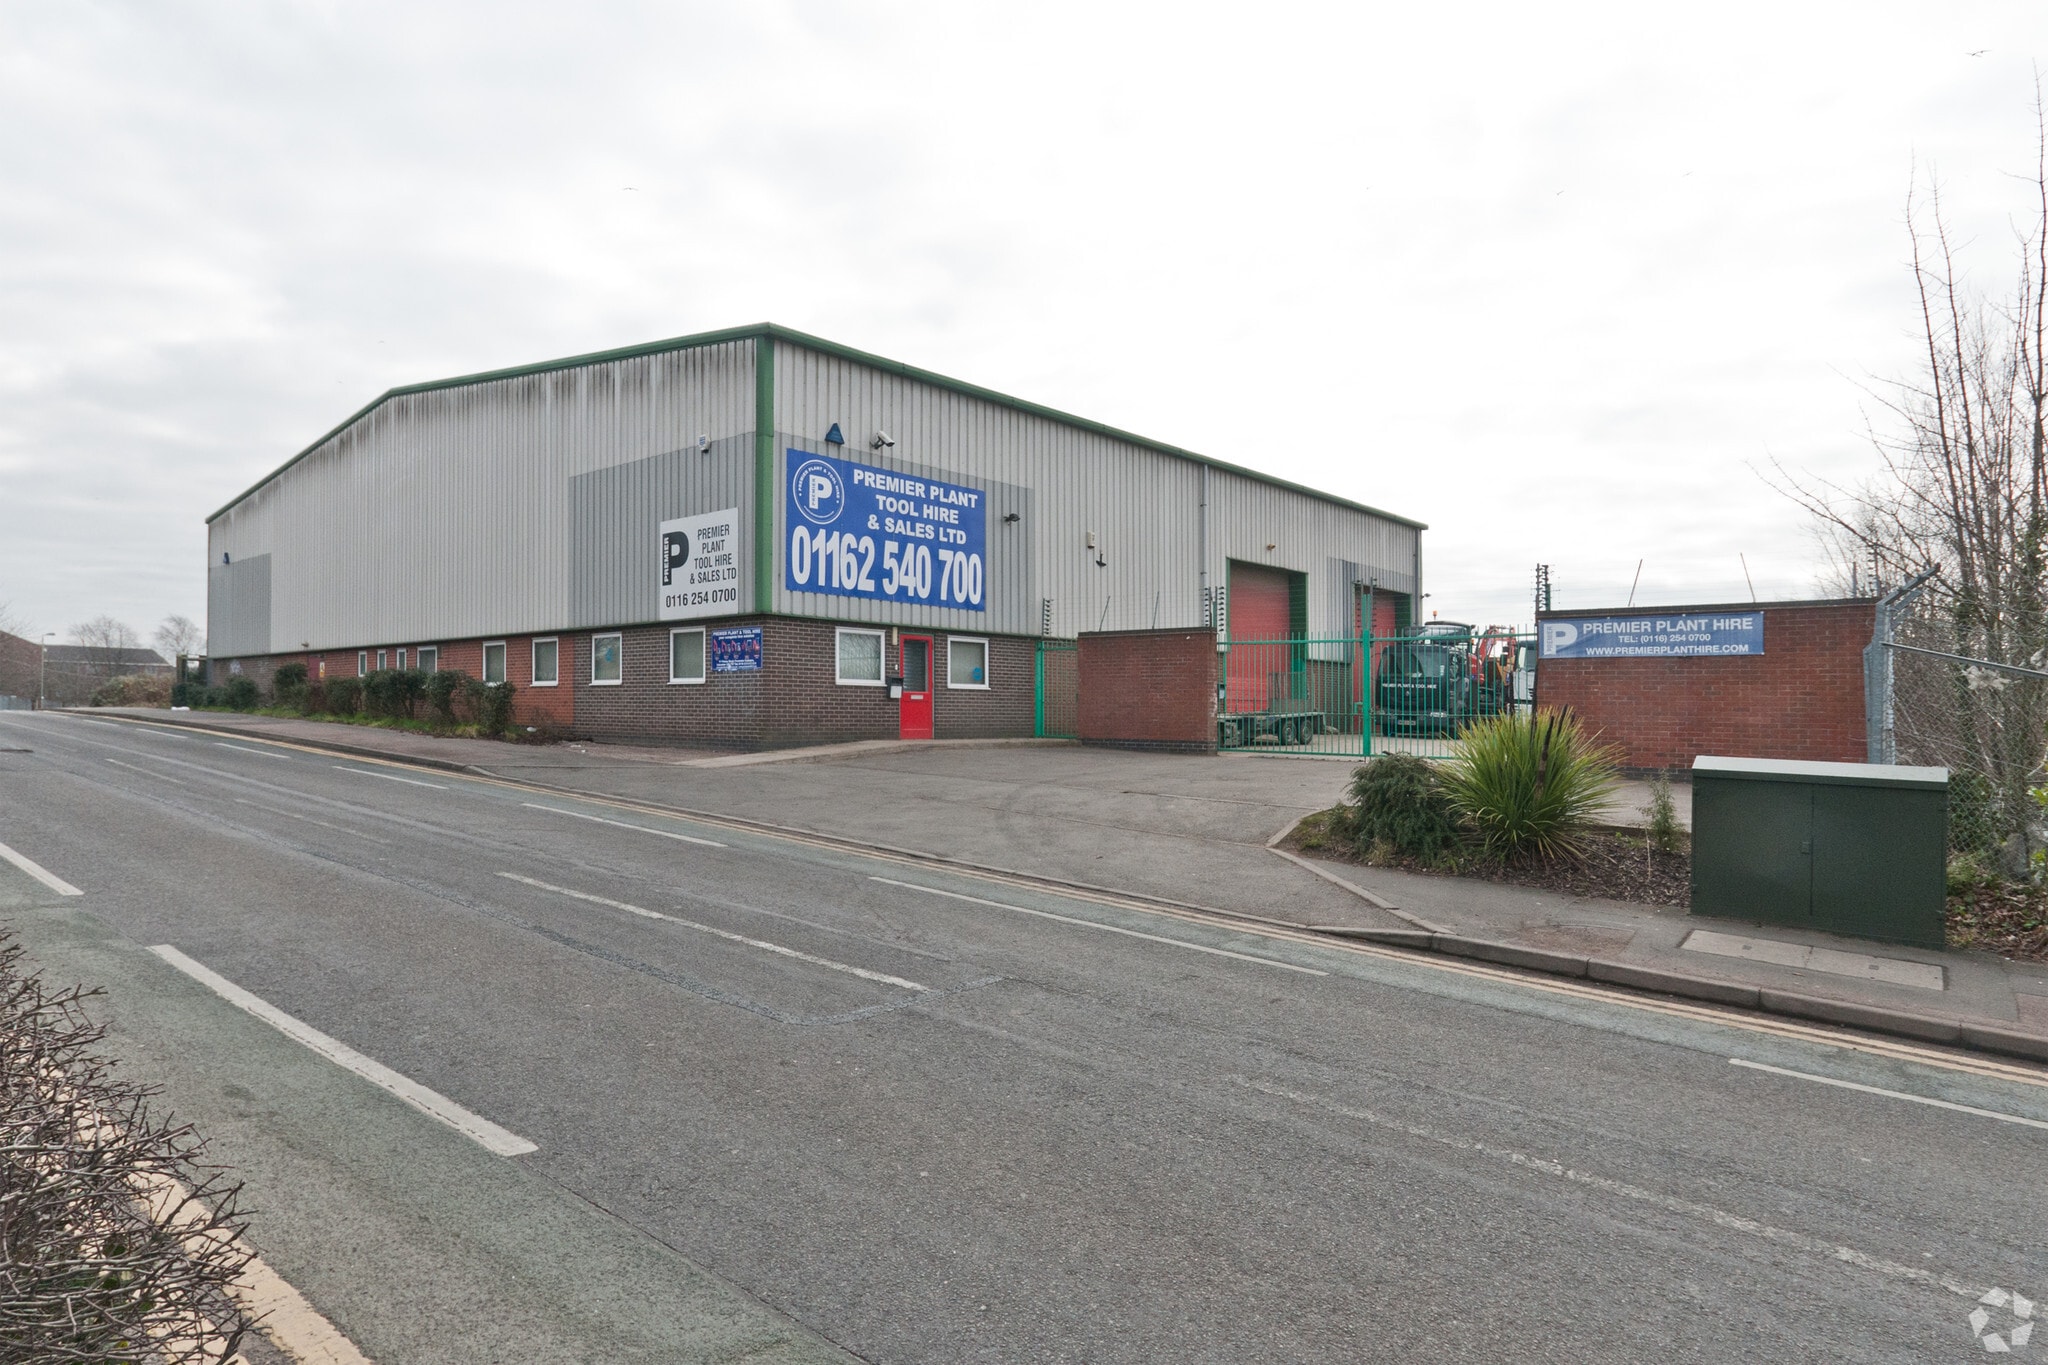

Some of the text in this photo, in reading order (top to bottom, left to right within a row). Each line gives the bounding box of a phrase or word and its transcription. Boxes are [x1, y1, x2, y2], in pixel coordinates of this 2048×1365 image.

[809, 474, 832, 509] P
[854, 468, 978, 508] PREMIER PLANT
[876, 494, 959, 524] TOOL HIRE
[698, 524, 730, 540] PREMIER
[868, 514, 966, 544] & SALES LTD
[702, 540, 726, 554] PLANT
[662, 530, 690, 586] P
[694, 553, 732, 570] TOOL HIRE
[792, 525, 982, 605] 01162 540 700
[690, 568, 736, 584] & SALES LTD
[666, 588, 736, 608] 0116 254 0700
[1582, 618, 1753, 634] PREMIER PLANT HIRE
[1544, 623, 1578, 656] P
[1640, 634, 1668, 644] (0116)
[1670, 634, 1686, 642] 254
[1688, 633, 1711, 642] 0700
[1586, 644, 1748, 655] WWW.PREMIERPLANTHIRE.COM
